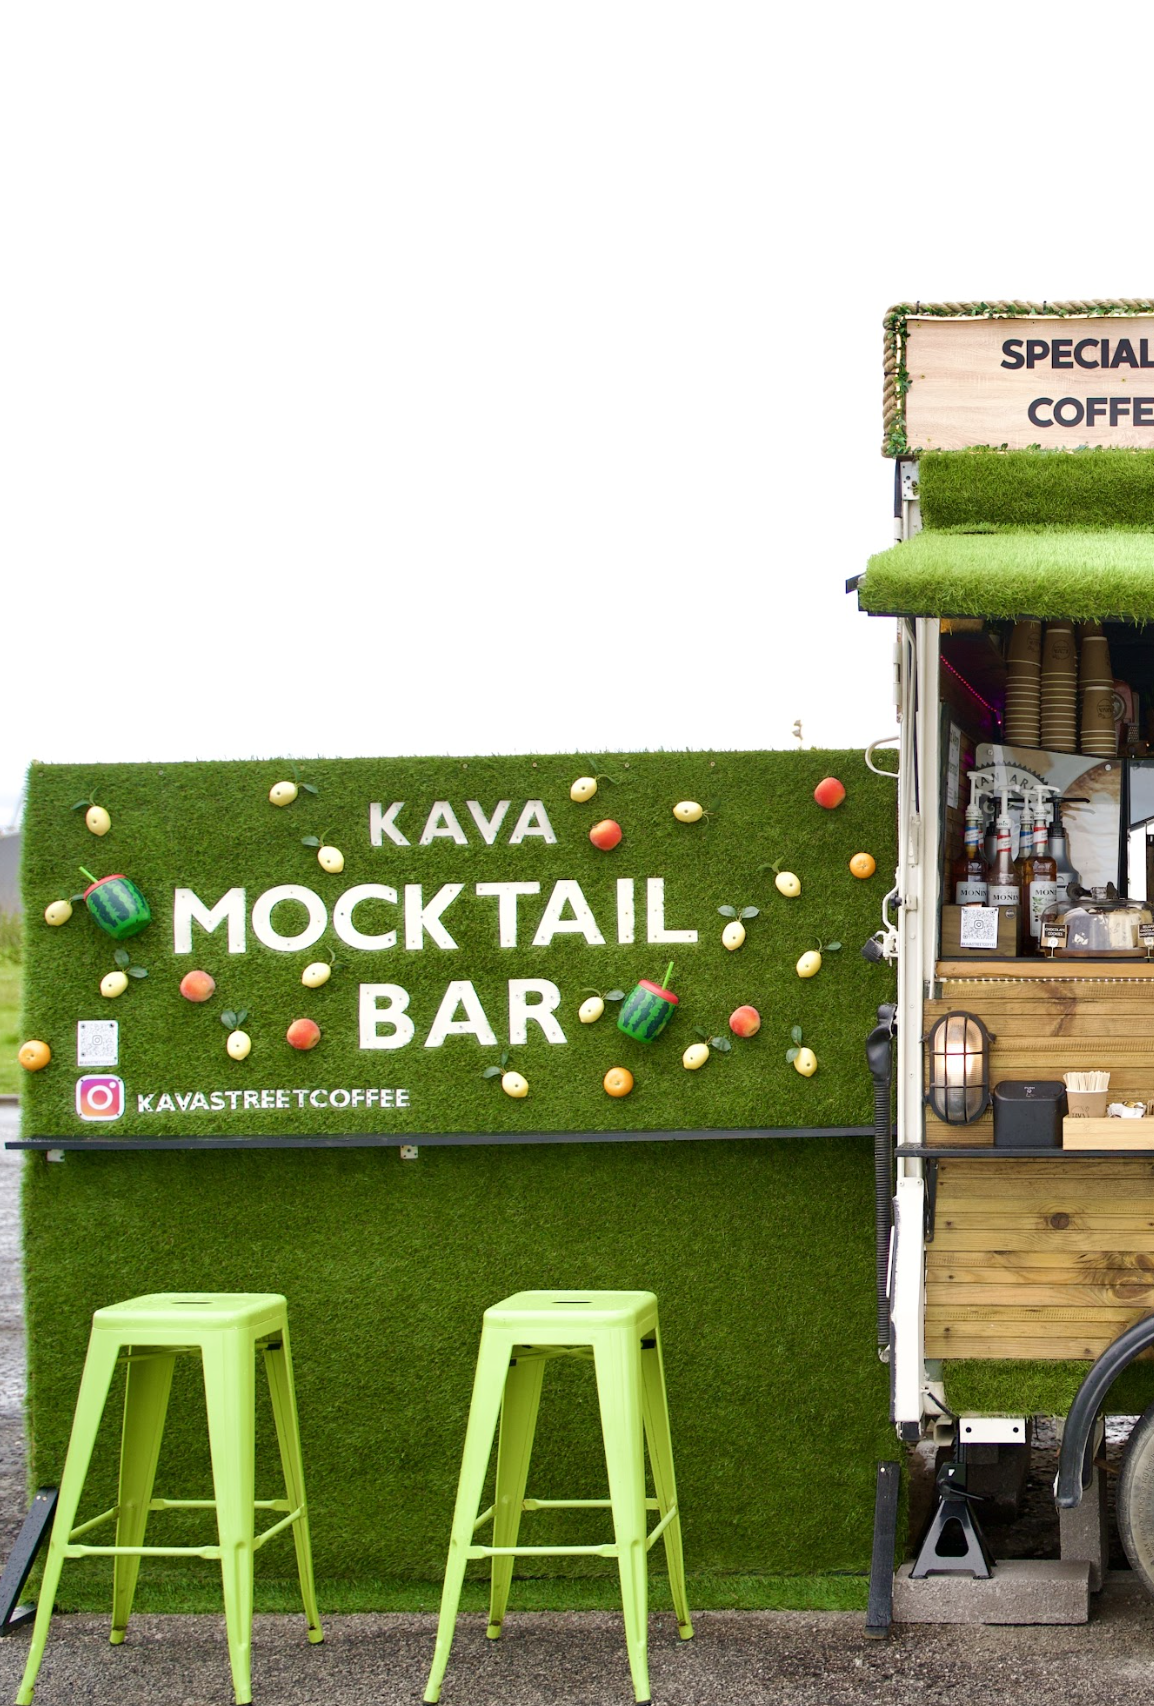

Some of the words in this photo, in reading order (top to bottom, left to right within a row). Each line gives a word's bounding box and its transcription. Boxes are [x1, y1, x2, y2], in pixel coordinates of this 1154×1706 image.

[369, 799, 559, 847] KAVA
[173, 877, 699, 954] MOCKTAIL
[358, 978, 568, 1050] BAR
